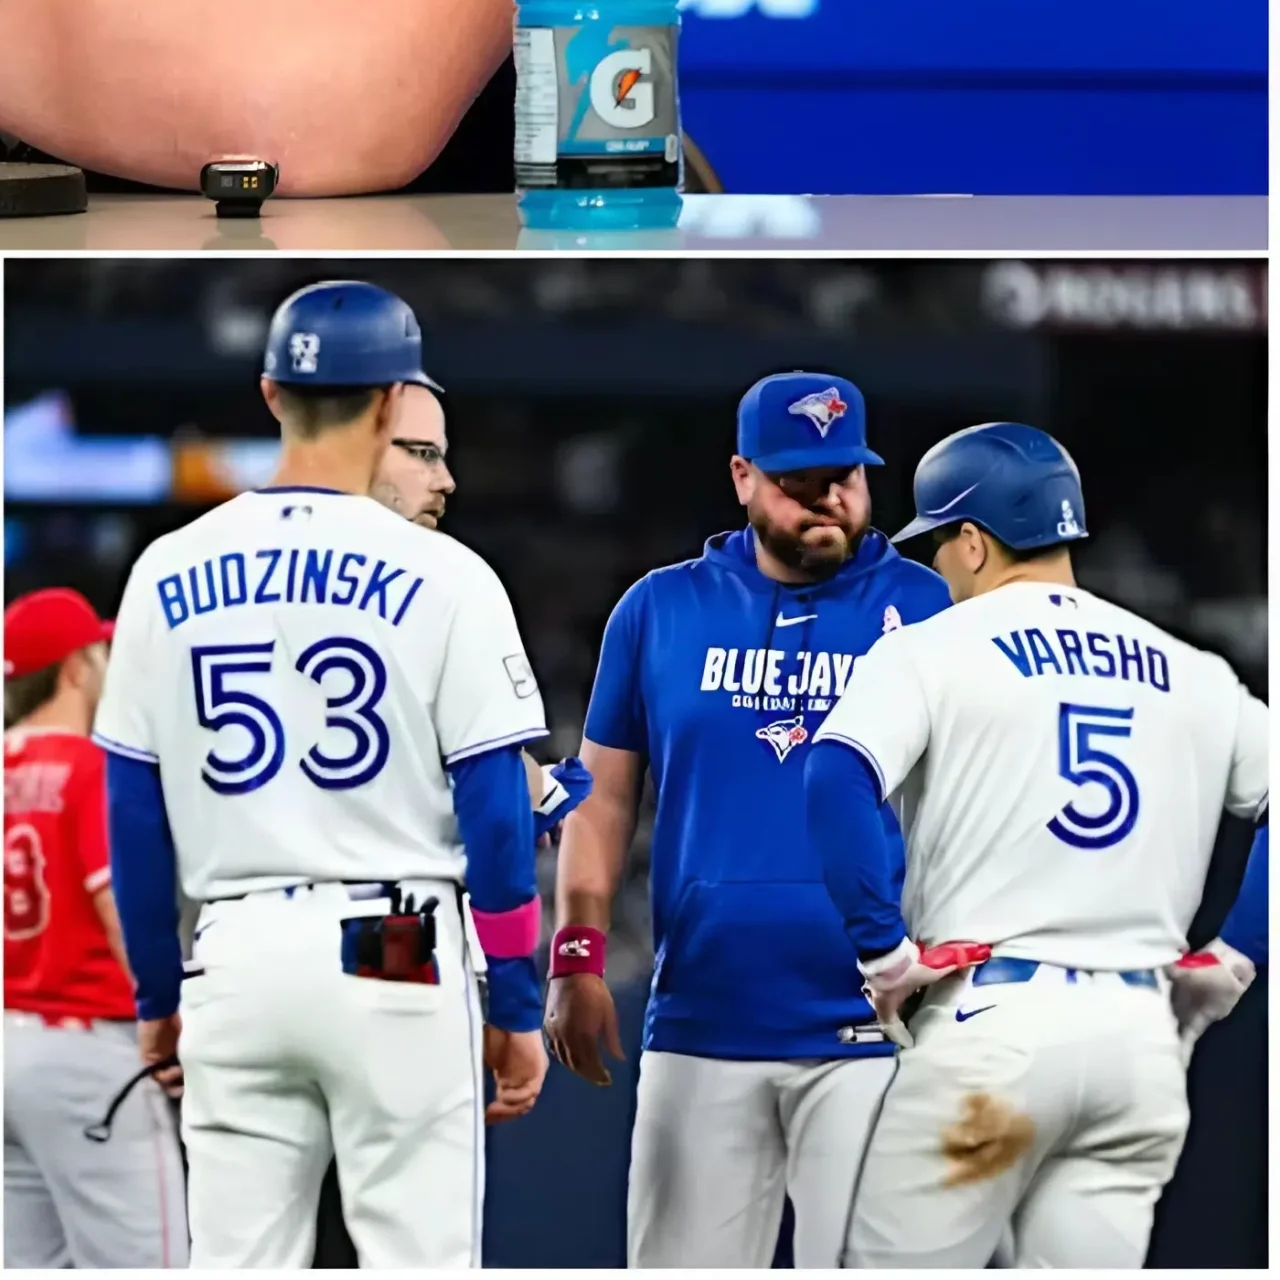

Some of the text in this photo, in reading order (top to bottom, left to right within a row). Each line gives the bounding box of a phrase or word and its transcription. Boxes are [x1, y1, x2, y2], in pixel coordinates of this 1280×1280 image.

[590, 48, 654, 128] G
[157, 548, 424, 630] BUDZINSKI
[700, 647, 865, 696] BLUE JAY
[991, 627, 1171, 693] VARSHO
[190, 636, 391, 795] 53
[1046, 701, 1141, 851] 5
